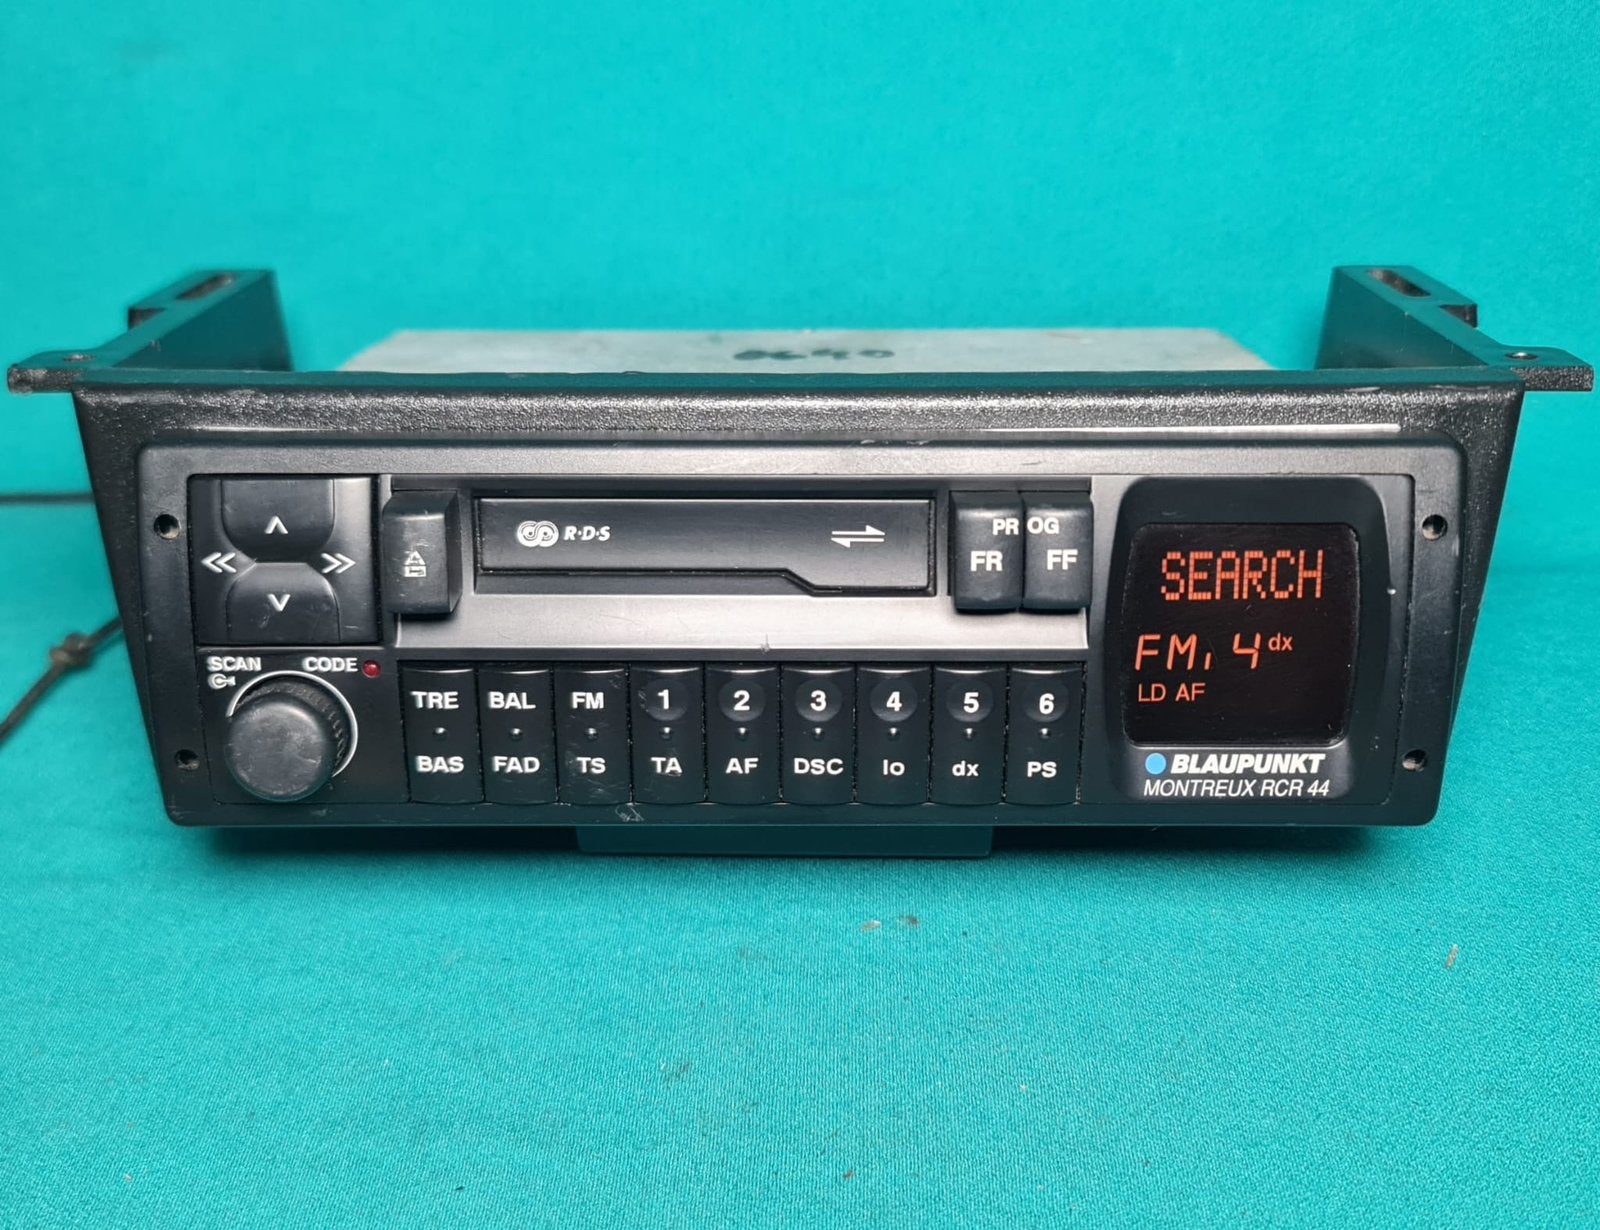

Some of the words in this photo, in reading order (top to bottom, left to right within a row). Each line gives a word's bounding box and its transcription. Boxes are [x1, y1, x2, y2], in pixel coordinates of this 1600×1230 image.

[970, 550, 1003, 572] FR
[1047, 549, 1078, 571] FF
[1161, 550, 1323, 601] SEARCH
[1232, 632, 1262, 670] 4
[1268, 633, 1293, 651] dx
[207, 656, 261, 672] SCAN
[302, 656, 358, 673] CODE
[412, 690, 459, 710] TRE
[489, 691, 536, 710] BAL
[572, 691, 605, 710] FM
[657, 690, 670, 710] 1
[733, 689, 750, 711] 2
[810, 689, 827, 711] 3
[886, 691, 902, 712] 4
[1138, 683, 1167, 702] LD
[1175, 683, 1206, 702] AF
[963, 692, 980, 713] 5
[1039, 693, 1055, 714] 6
[416, 755, 465, 773] BAS
[492, 755, 541, 774] FAD
[576, 756, 606, 774] TS
[651, 757, 683, 774] TA
[726, 757, 759, 775] AF
[793, 757, 844, 775] DSC
[952, 760, 979, 777] dx
[1027, 761, 1057, 777] PS
[1171, 753, 1326, 774] BLAUPUNKT
[1143, 778, 1255, 797] MONTREUX
[1260, 778, 1303, 797] RCR
[1307, 779, 1331, 797] 44
